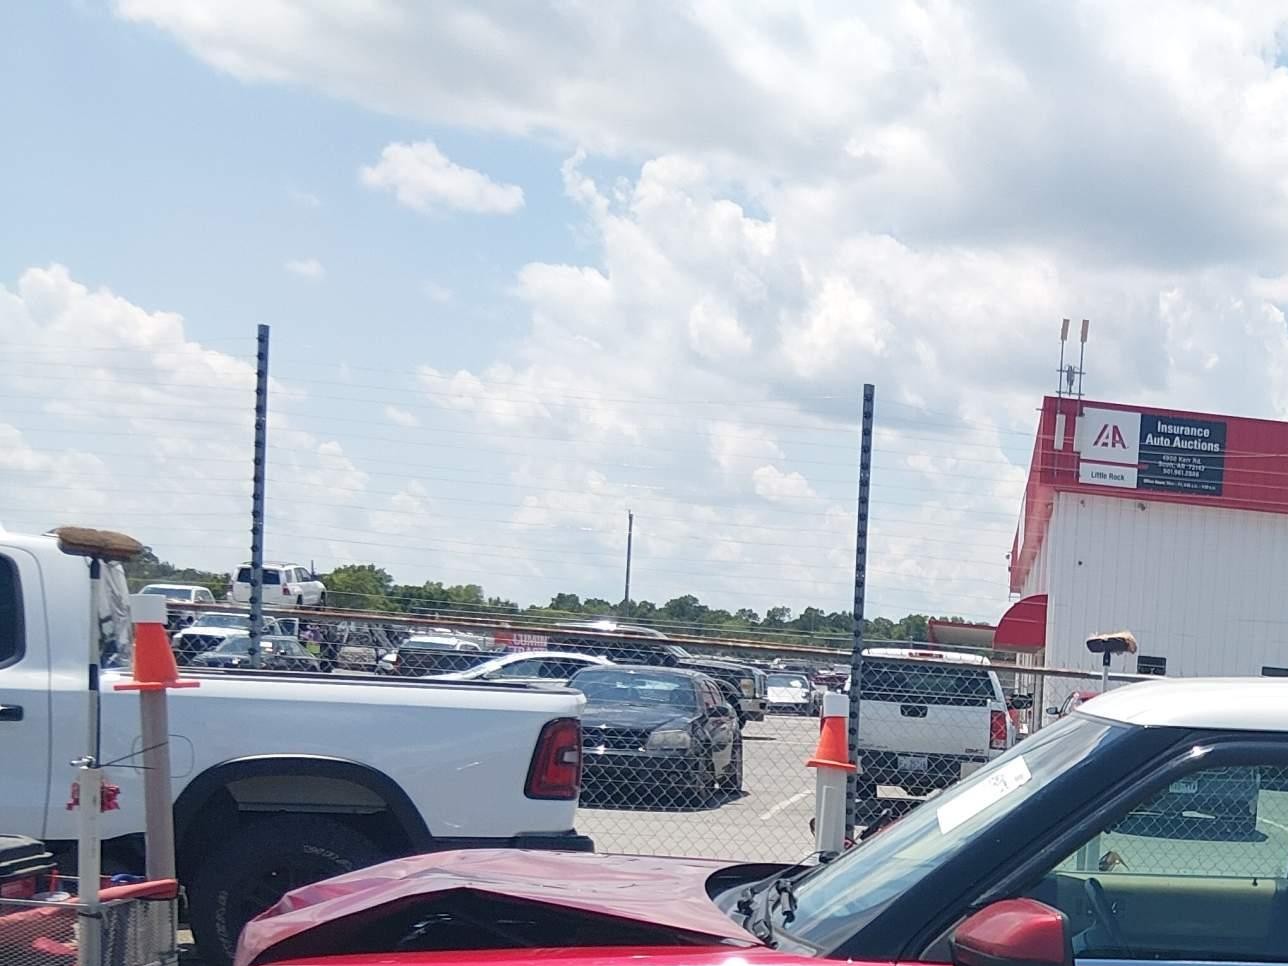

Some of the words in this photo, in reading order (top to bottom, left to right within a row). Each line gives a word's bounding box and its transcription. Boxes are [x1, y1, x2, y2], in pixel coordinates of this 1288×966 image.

[1157, 420, 1210, 437] Insurance
[1145, 433, 1171, 446] Auto
[1173, 436, 1220, 452] Auctions
[1090, 471, 1108, 480] Little
[1108, 473, 1125, 481] Rock
